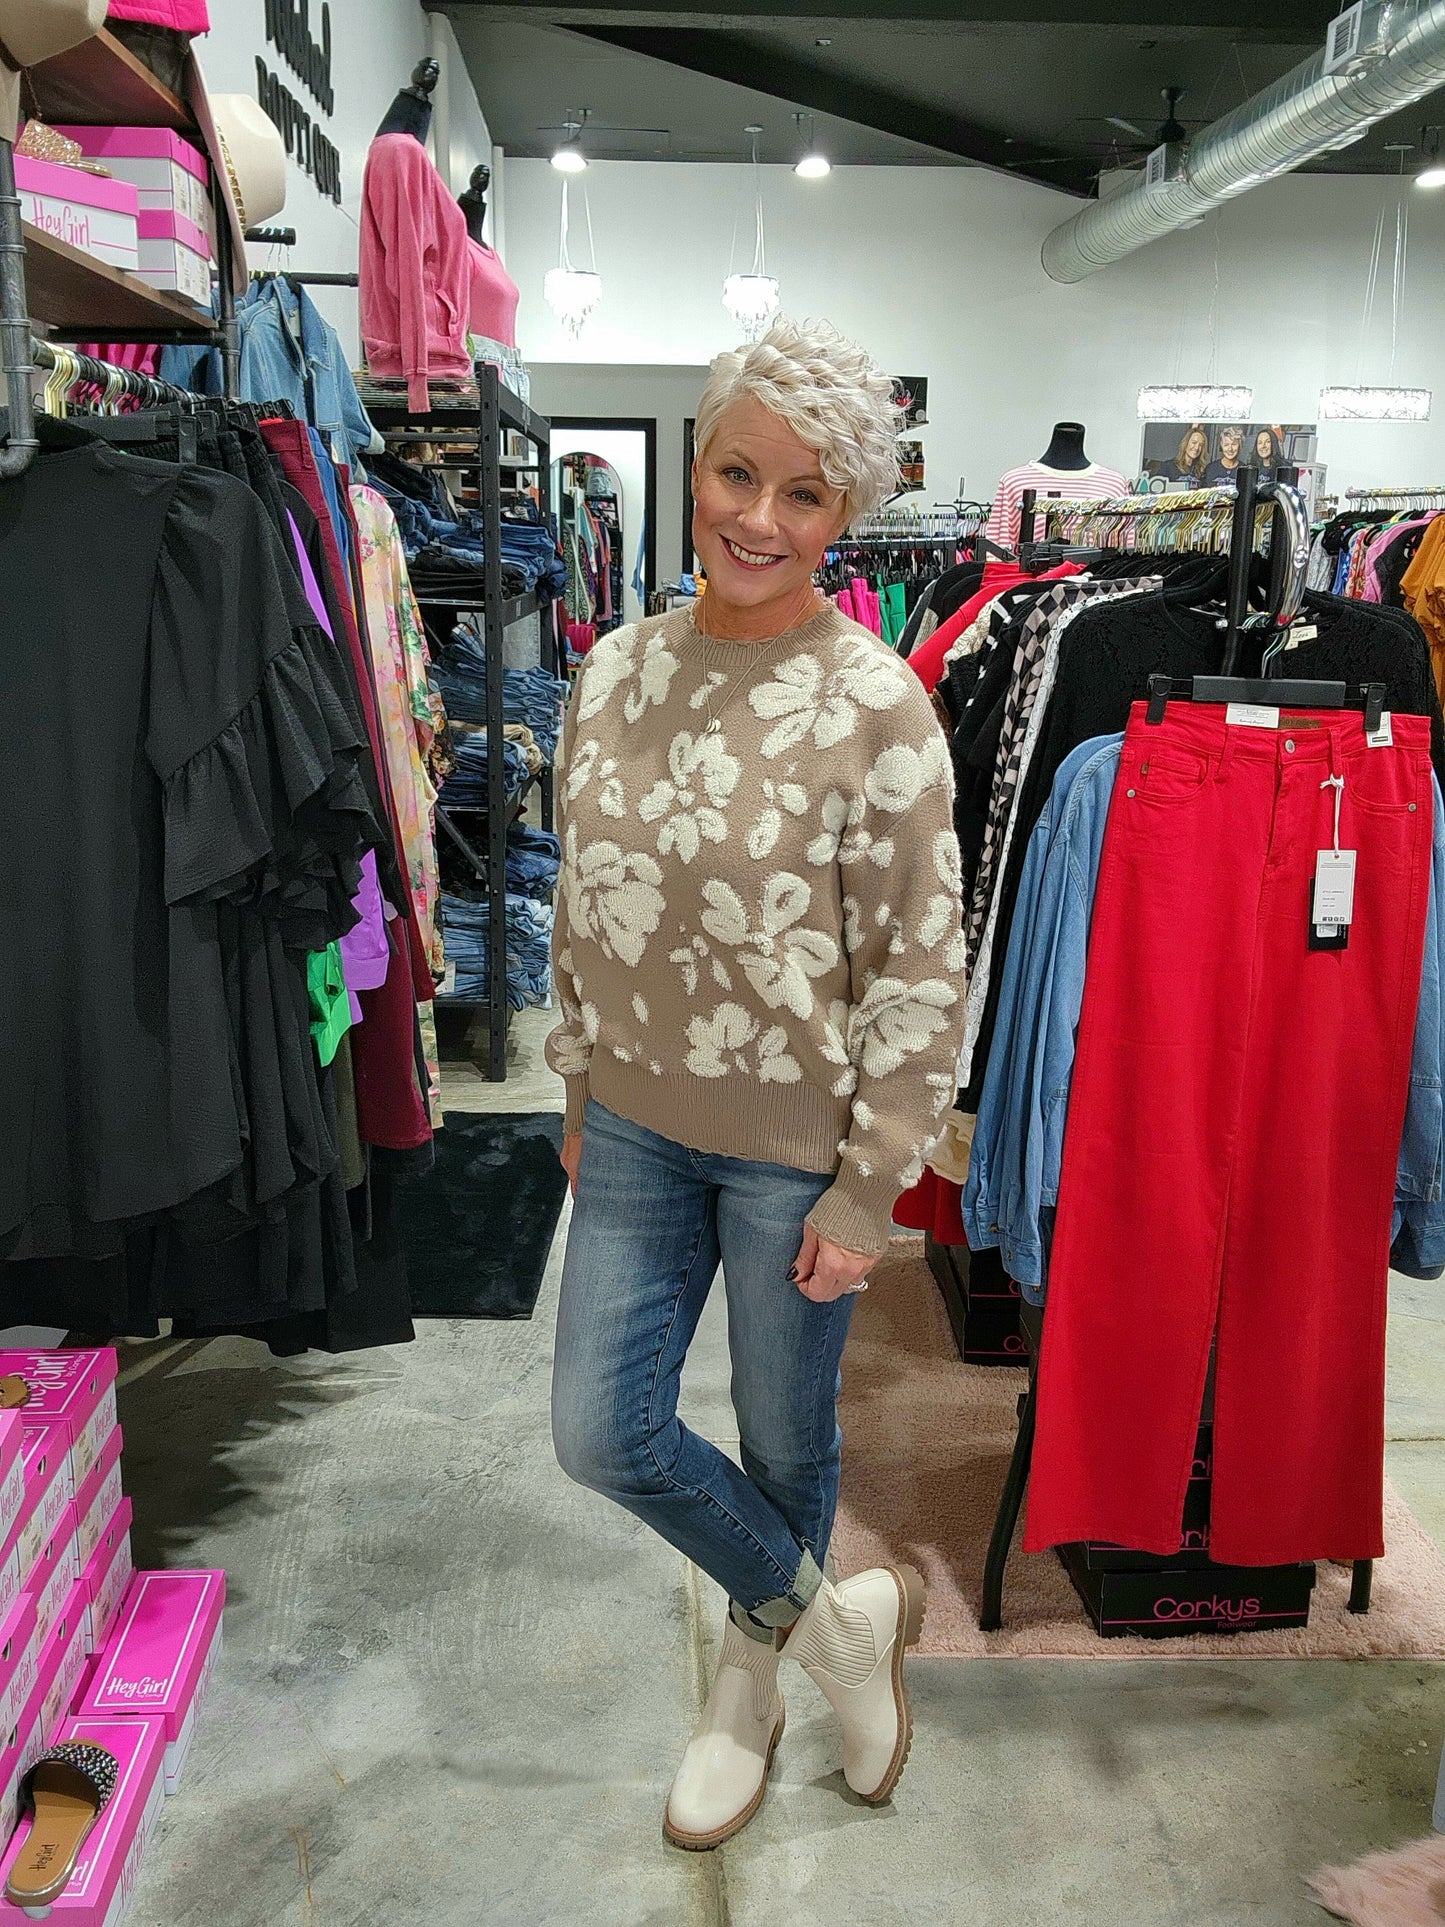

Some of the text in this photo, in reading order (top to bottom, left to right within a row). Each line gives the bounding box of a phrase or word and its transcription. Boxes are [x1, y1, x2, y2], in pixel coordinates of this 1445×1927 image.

[1153, 1594, 1261, 1621] Corkys
[1217, 1619, 1258, 1629] Footwear
[106, 1676, 168, 1698] HeyGirl
